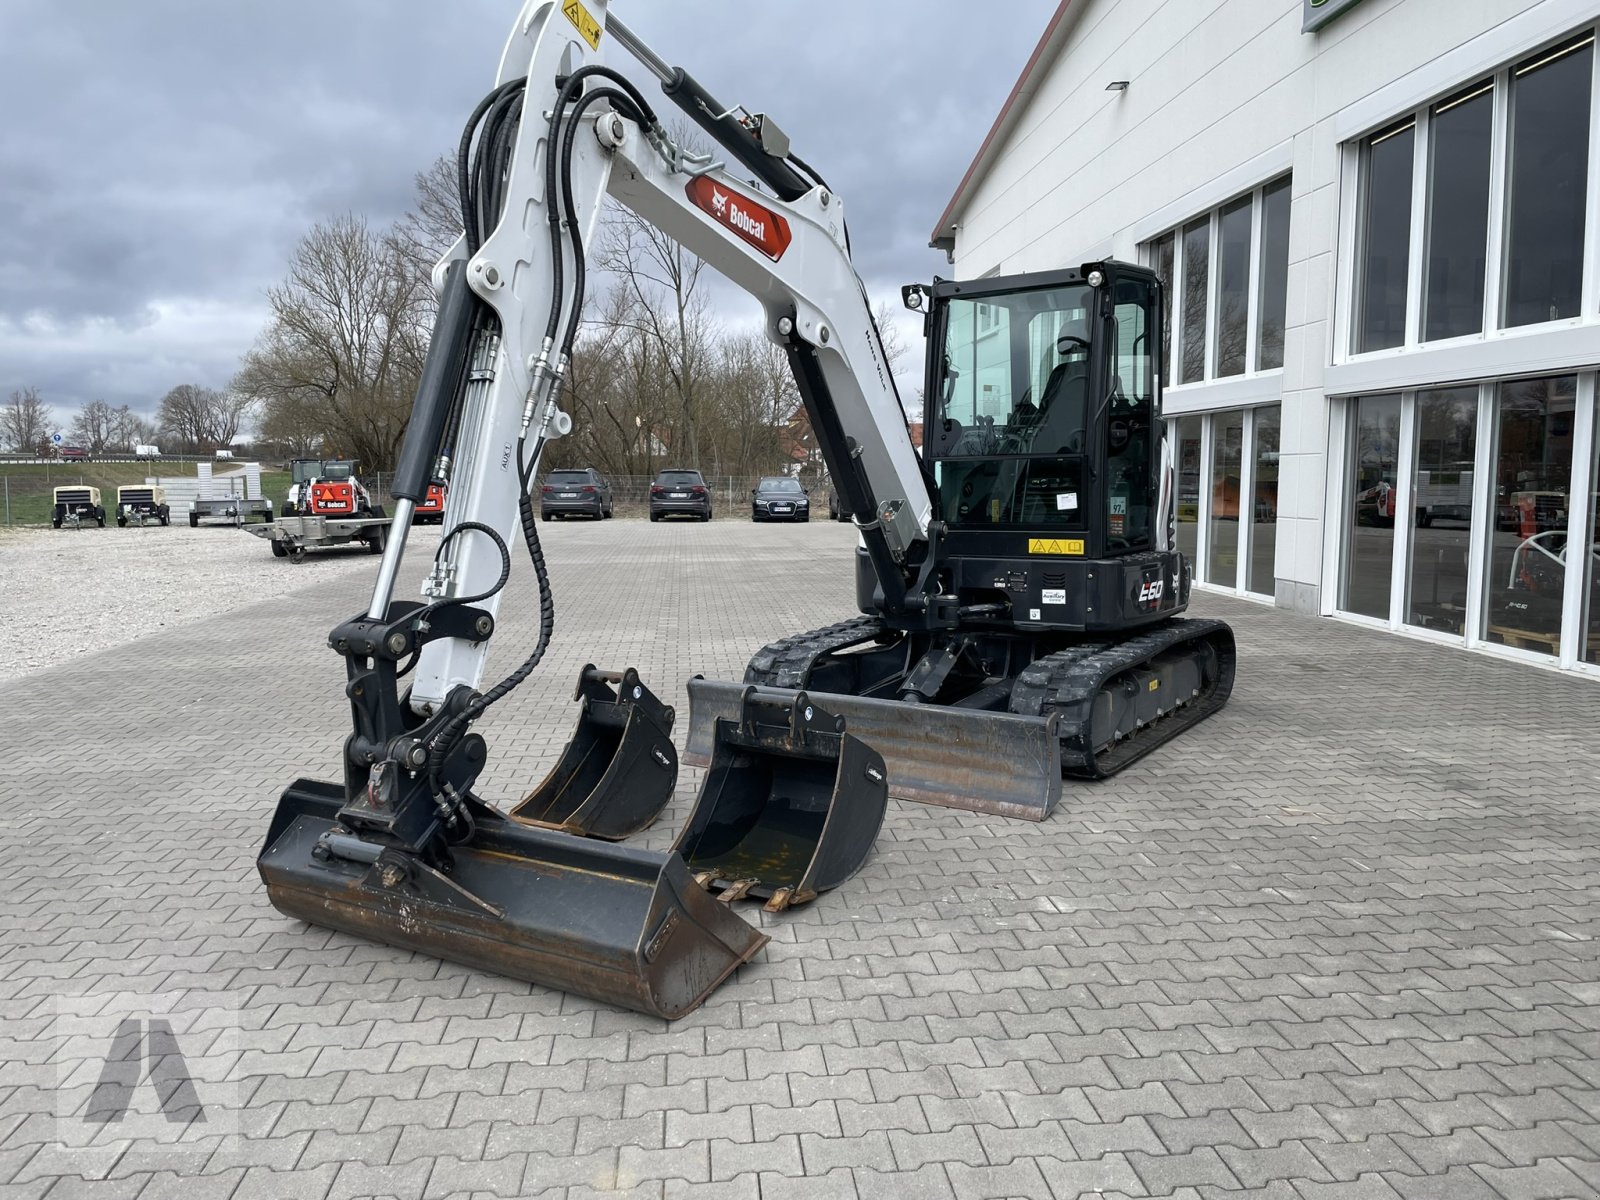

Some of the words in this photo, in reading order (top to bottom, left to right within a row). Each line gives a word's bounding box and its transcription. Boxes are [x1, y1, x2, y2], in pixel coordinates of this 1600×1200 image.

[730, 203, 765, 241] Bobcat
[502, 451, 510, 468] AUX
[1138, 580, 1164, 602] E60
